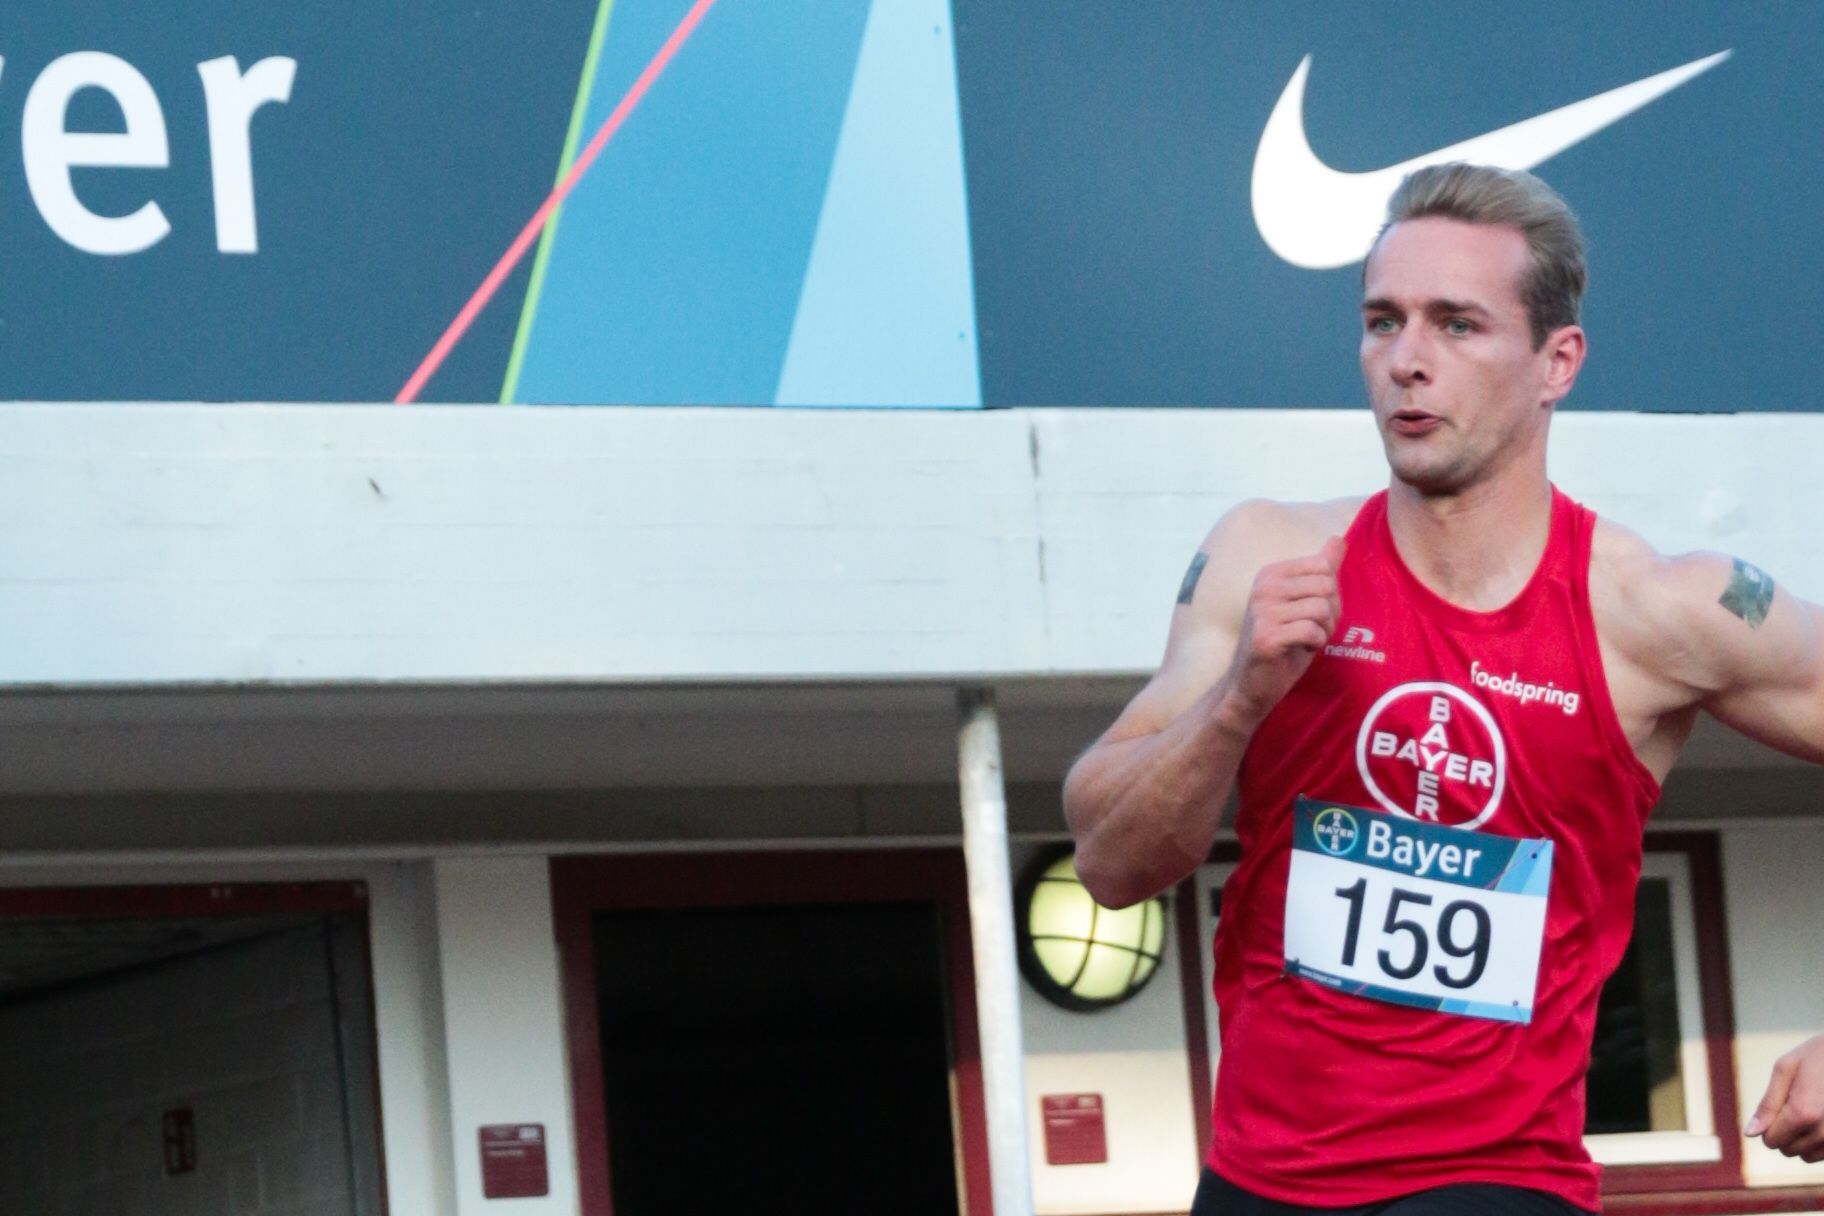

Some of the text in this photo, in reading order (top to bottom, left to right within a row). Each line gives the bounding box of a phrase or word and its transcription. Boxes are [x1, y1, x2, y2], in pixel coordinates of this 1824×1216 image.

[0, 51, 297, 255] er
[1324, 644, 1386, 664] newline
[1470, 660, 1580, 715] foodspring
[1371, 731, 1494, 788] BAYER
[1414, 695, 1452, 822] BAYER
[1366, 819, 1481, 878] Bayer
[1335, 876, 1492, 990] 159
